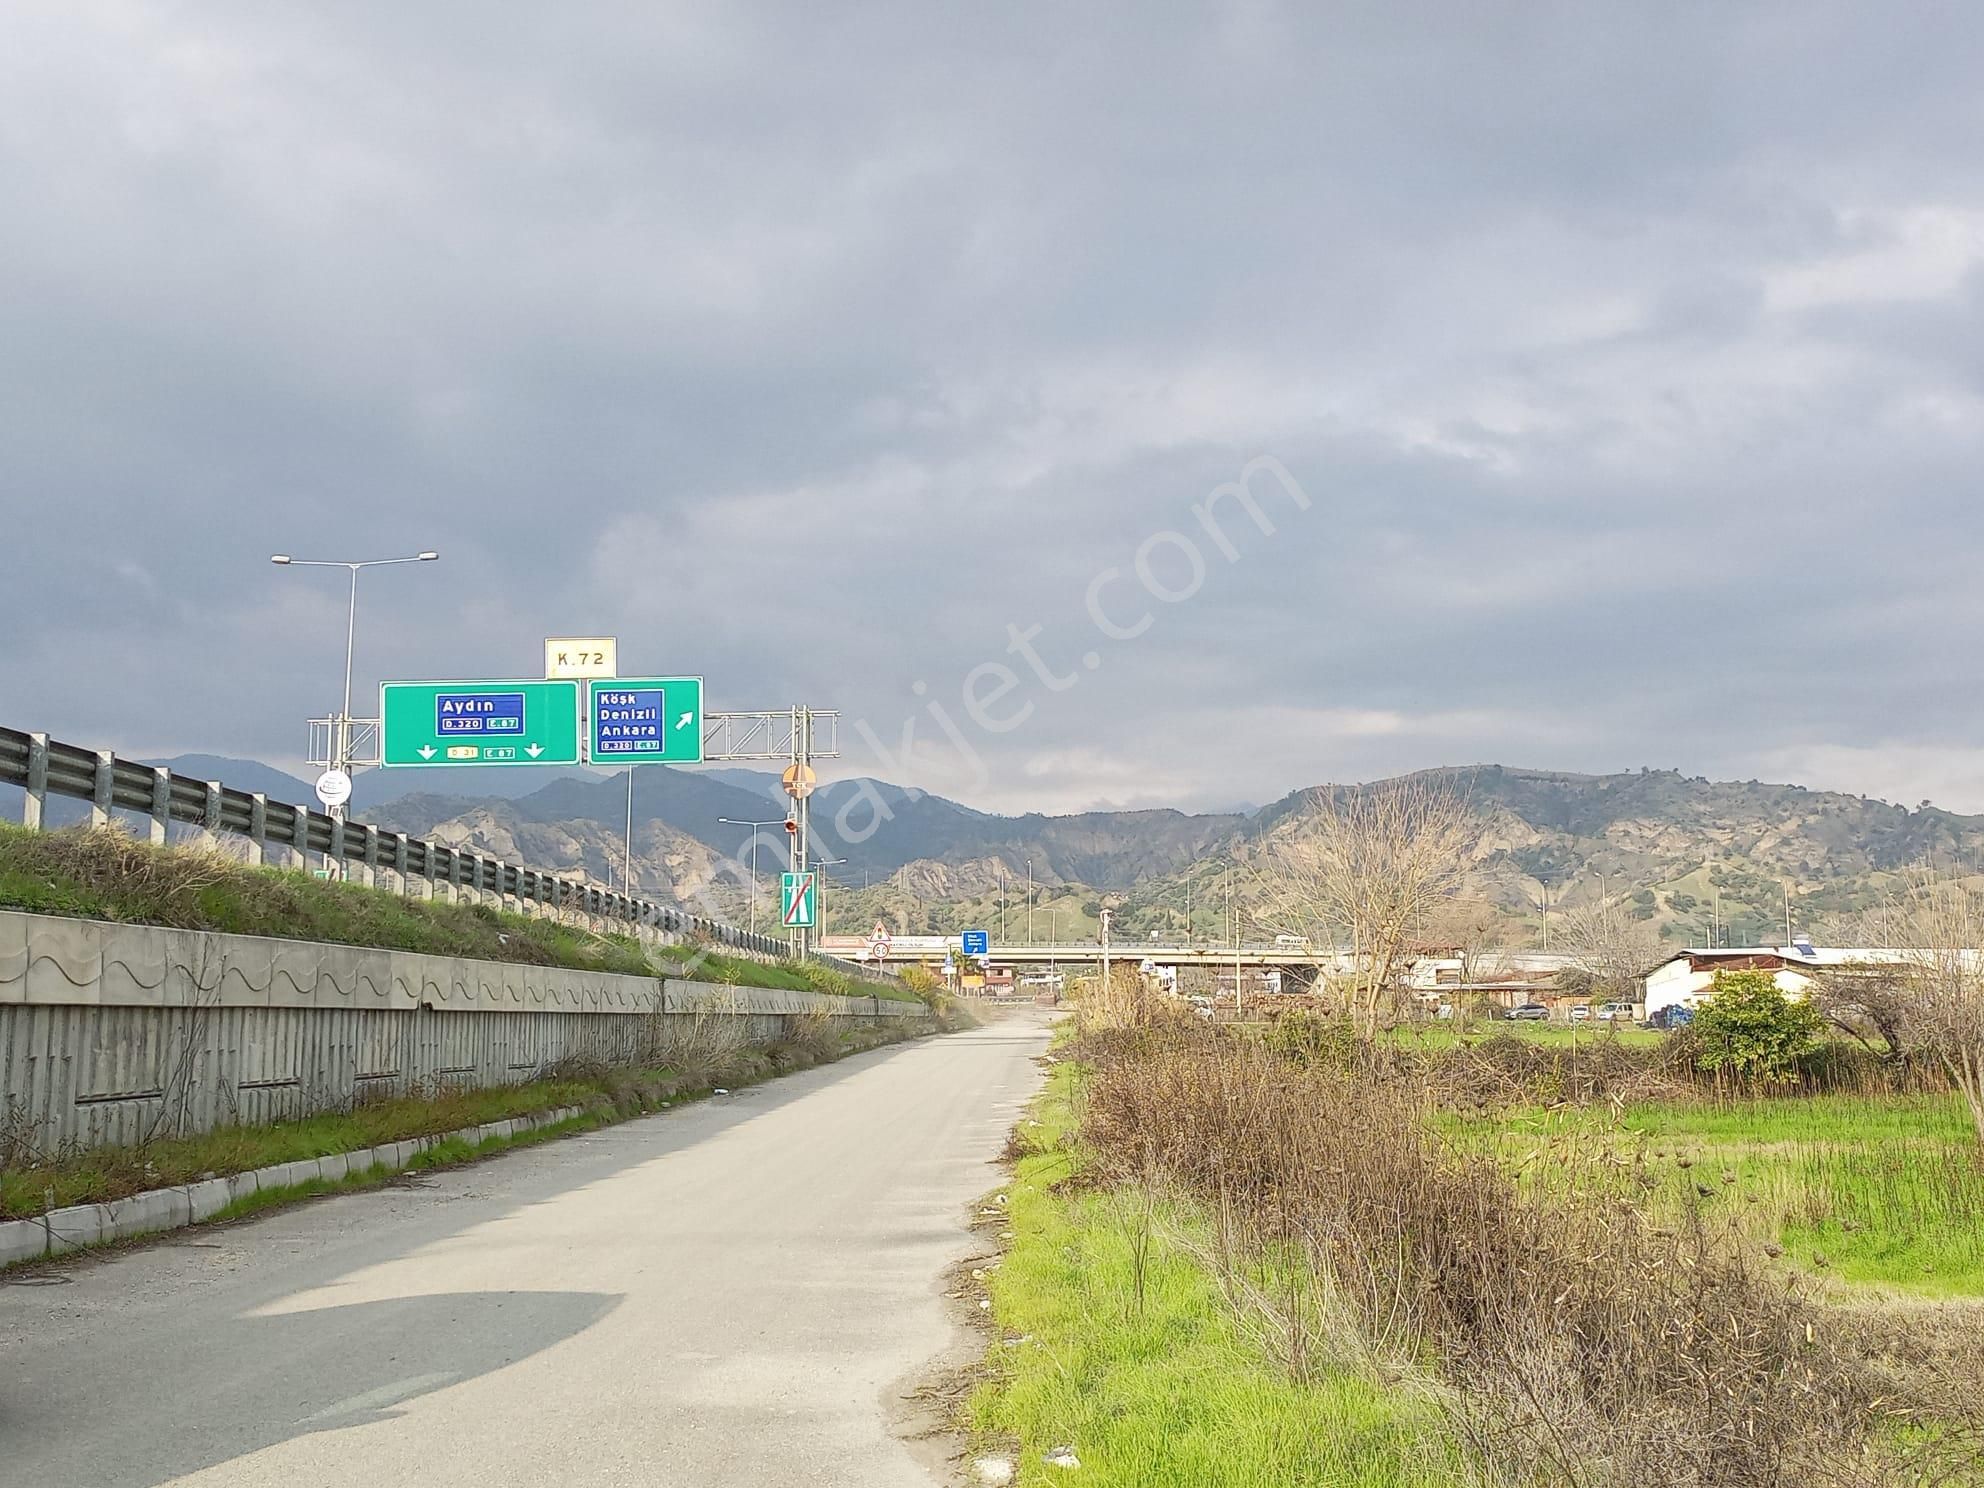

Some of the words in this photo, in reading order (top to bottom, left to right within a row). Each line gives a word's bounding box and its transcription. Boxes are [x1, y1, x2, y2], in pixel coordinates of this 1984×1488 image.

[558, 652, 604, 666] K.72
[600, 693, 636, 705] Köşk
[442, 699, 495, 715] Aydın
[600, 708, 656, 720] Denizli
[601, 725, 656, 736] Ankara
[876, 946, 887, 955] 50
